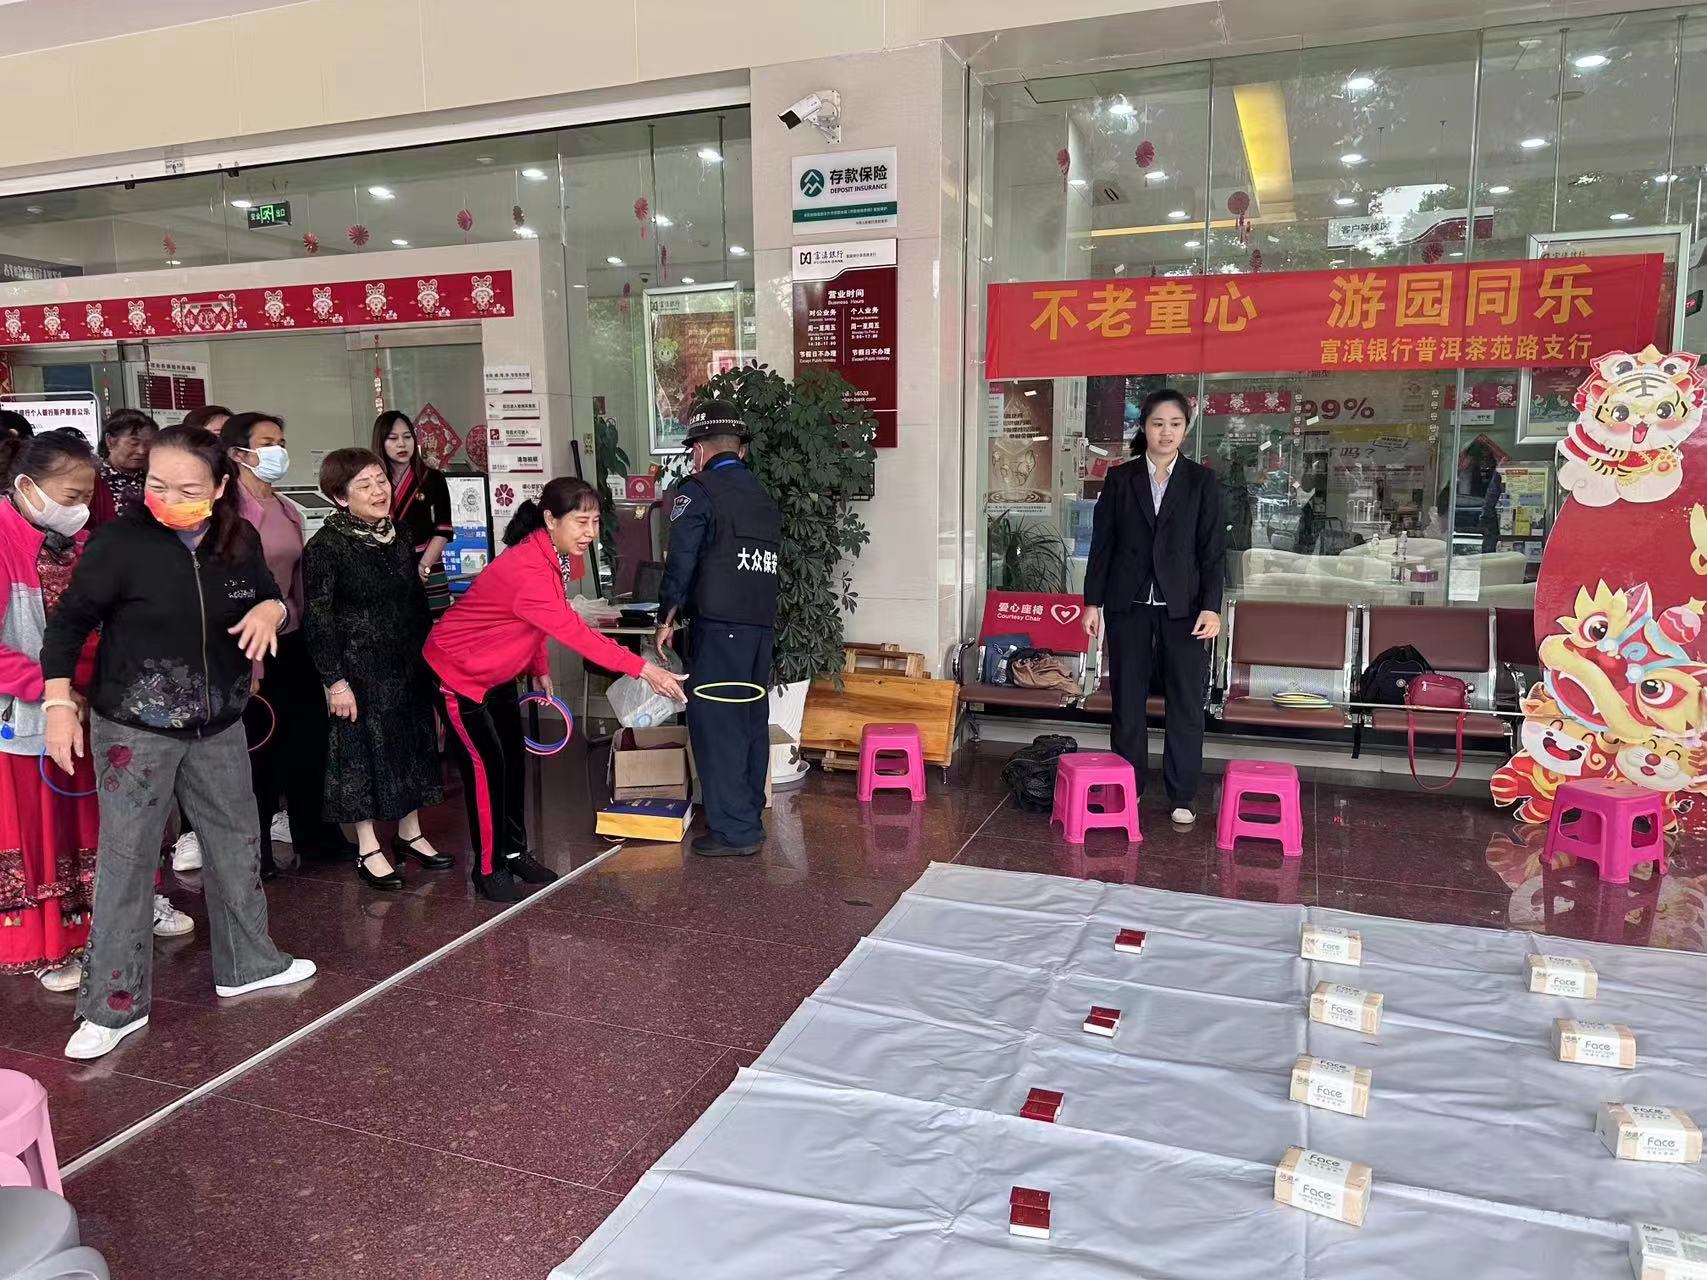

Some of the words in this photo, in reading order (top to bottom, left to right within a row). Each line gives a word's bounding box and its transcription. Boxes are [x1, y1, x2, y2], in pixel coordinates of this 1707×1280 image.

[829, 165, 887, 185] 存款保险
[855, 183, 887, 192] INSURANCE
[828, 289, 864, 299] 营业时间
[1030, 280, 1257, 341] 不老童心
[1326, 263, 1594, 329] 游园同乐
[809, 309, 836, 317] 对公业务
[850, 306, 879, 315] 个人业务
[808, 324, 836, 332] 周一至周五
[850, 322, 880, 330] 周一至周五
[799, 350, 837, 358] 节假日不办理
[852, 348, 891, 356] 节假日不办理
[1320, 334, 1591, 364] 富滇银行普洱茶苑路支行
[737, 547, 778, 575] 大众保安
[998, 602, 1043, 615] 爱心座椅
[1554, 977, 1576, 986] Face
[1331, 1004, 1353, 1016] Face
[1585, 1041, 1611, 1051] Face
[1317, 1085, 1342, 1098] Face
[1648, 1137, 1675, 1148] Face
[1310, 1154, 1341, 1167] Face
[1303, 1184, 1332, 1201] Face
